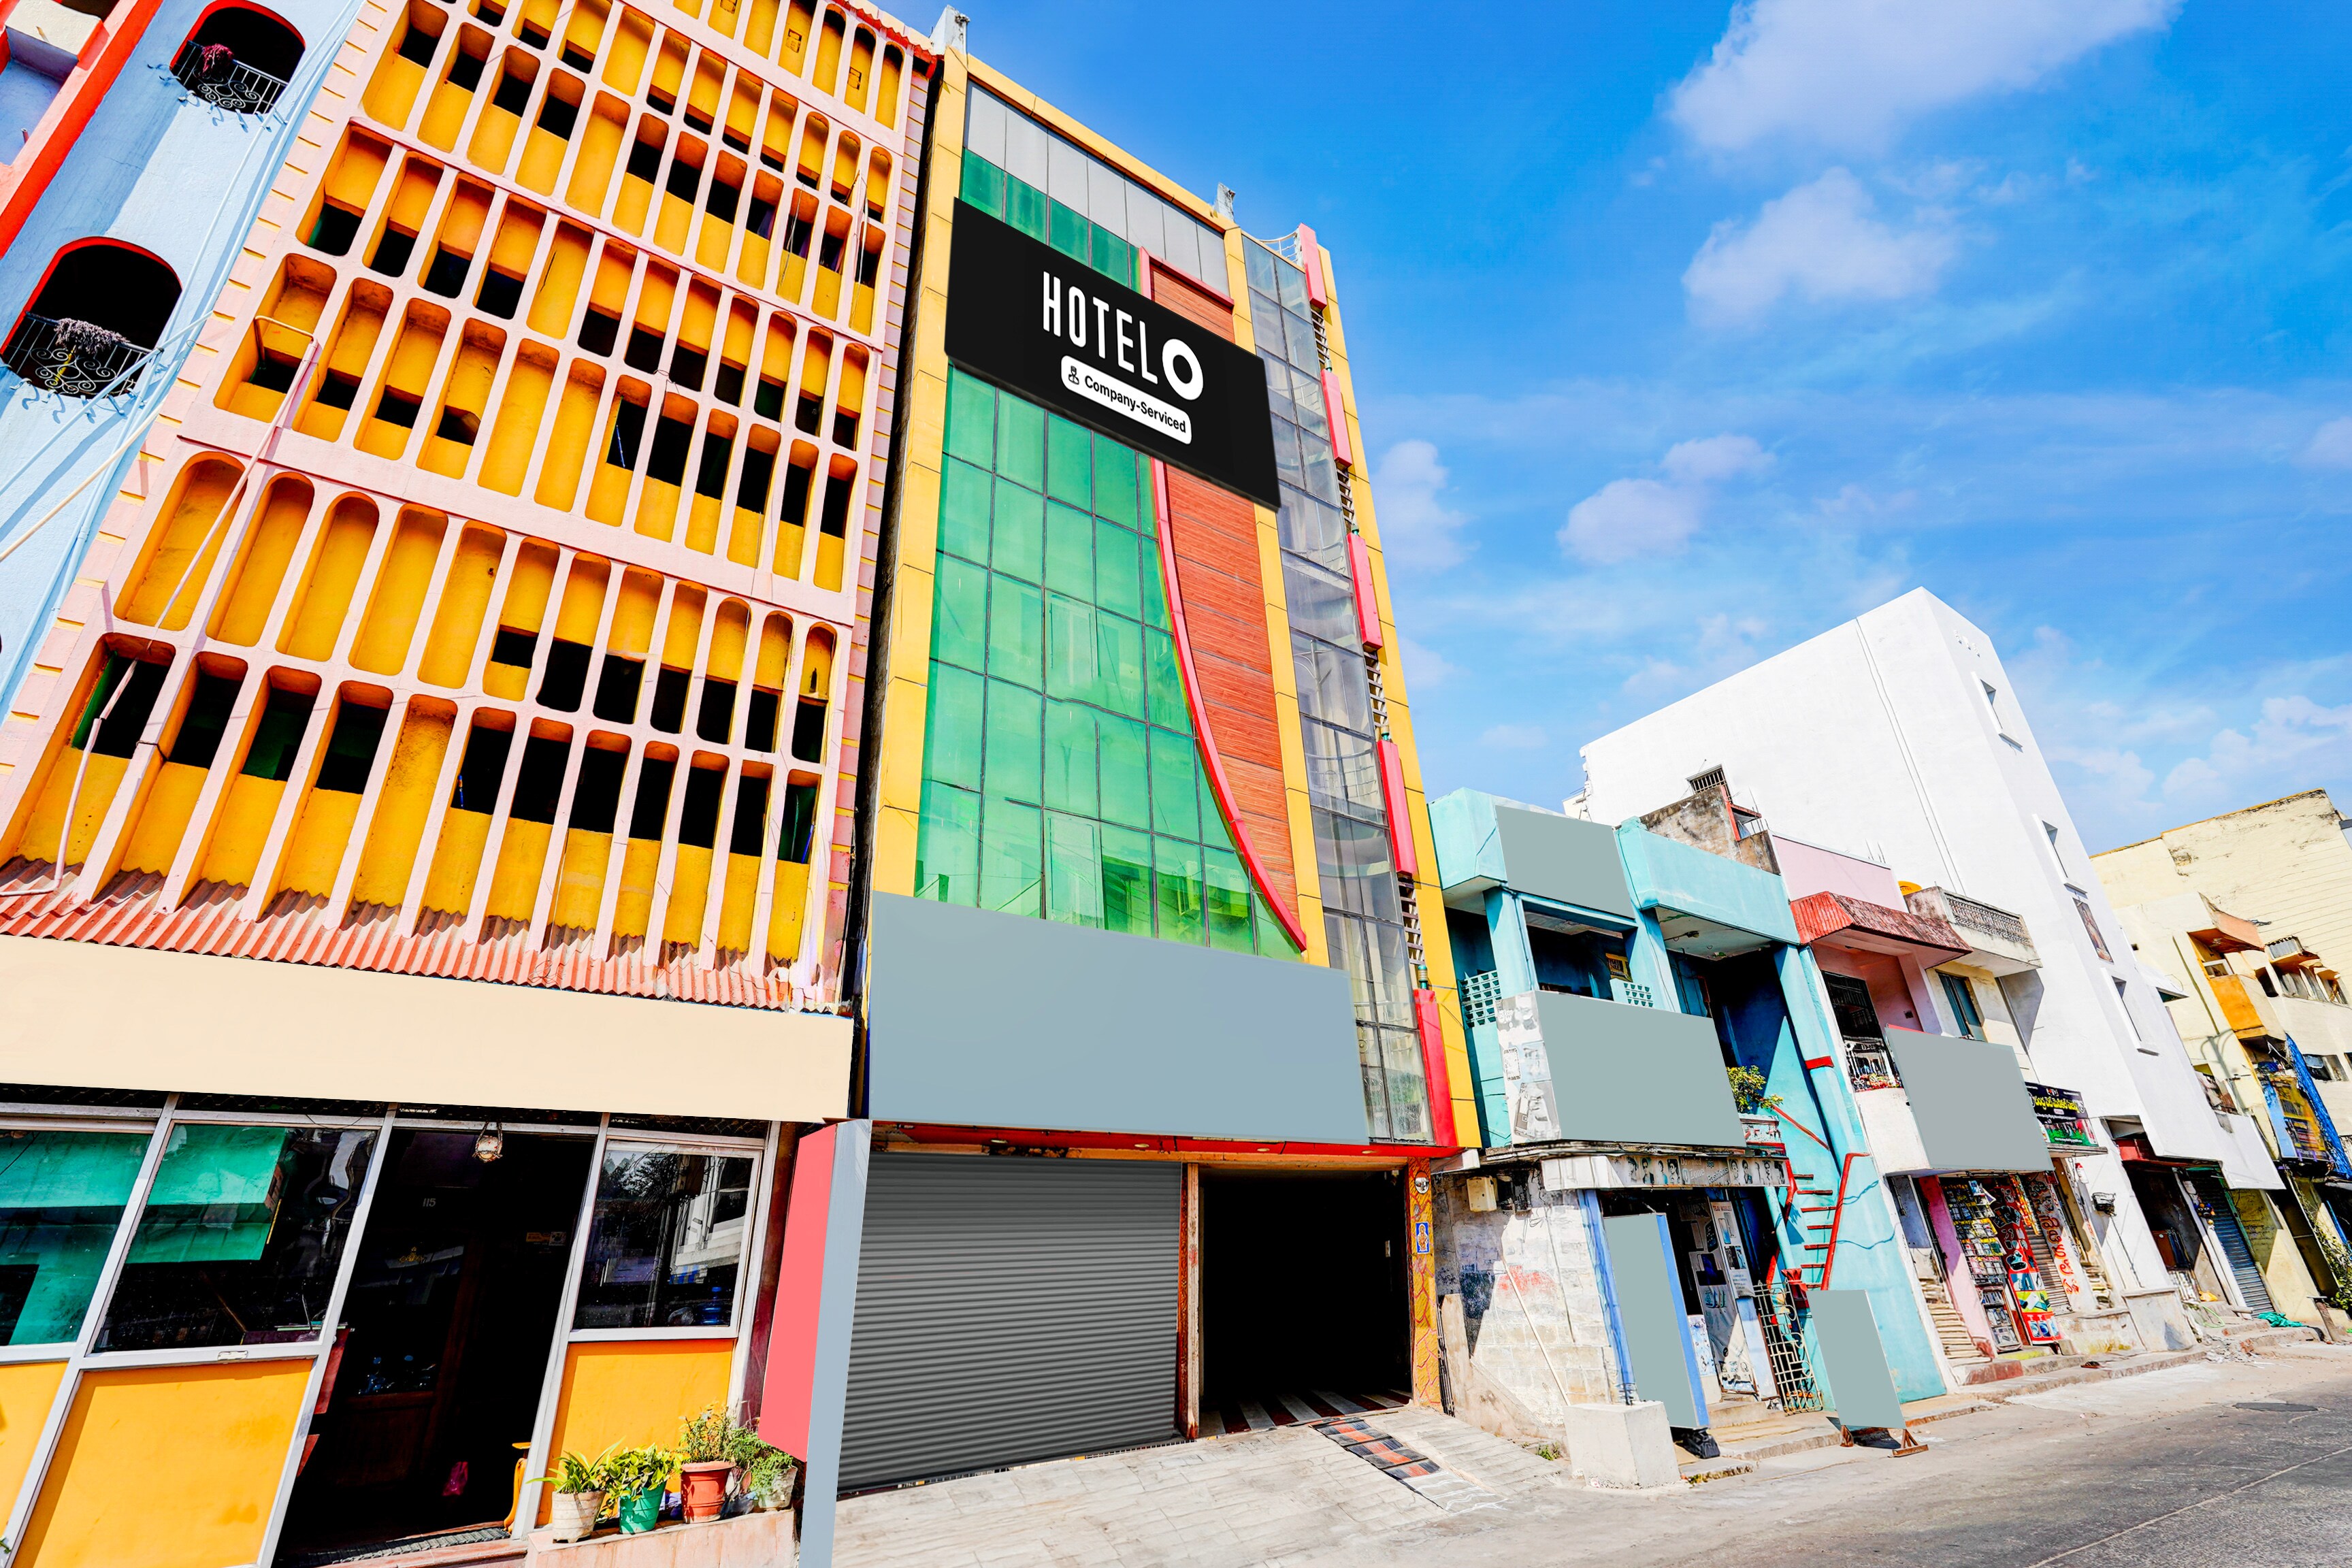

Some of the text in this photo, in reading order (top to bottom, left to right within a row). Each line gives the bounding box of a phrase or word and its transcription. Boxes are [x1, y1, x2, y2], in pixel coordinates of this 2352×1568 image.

[1043, 271, 1158, 385] HOTEL
[1084, 376, 1186, 433] Company-Serviced
[422, 1198, 436, 1207] 115
